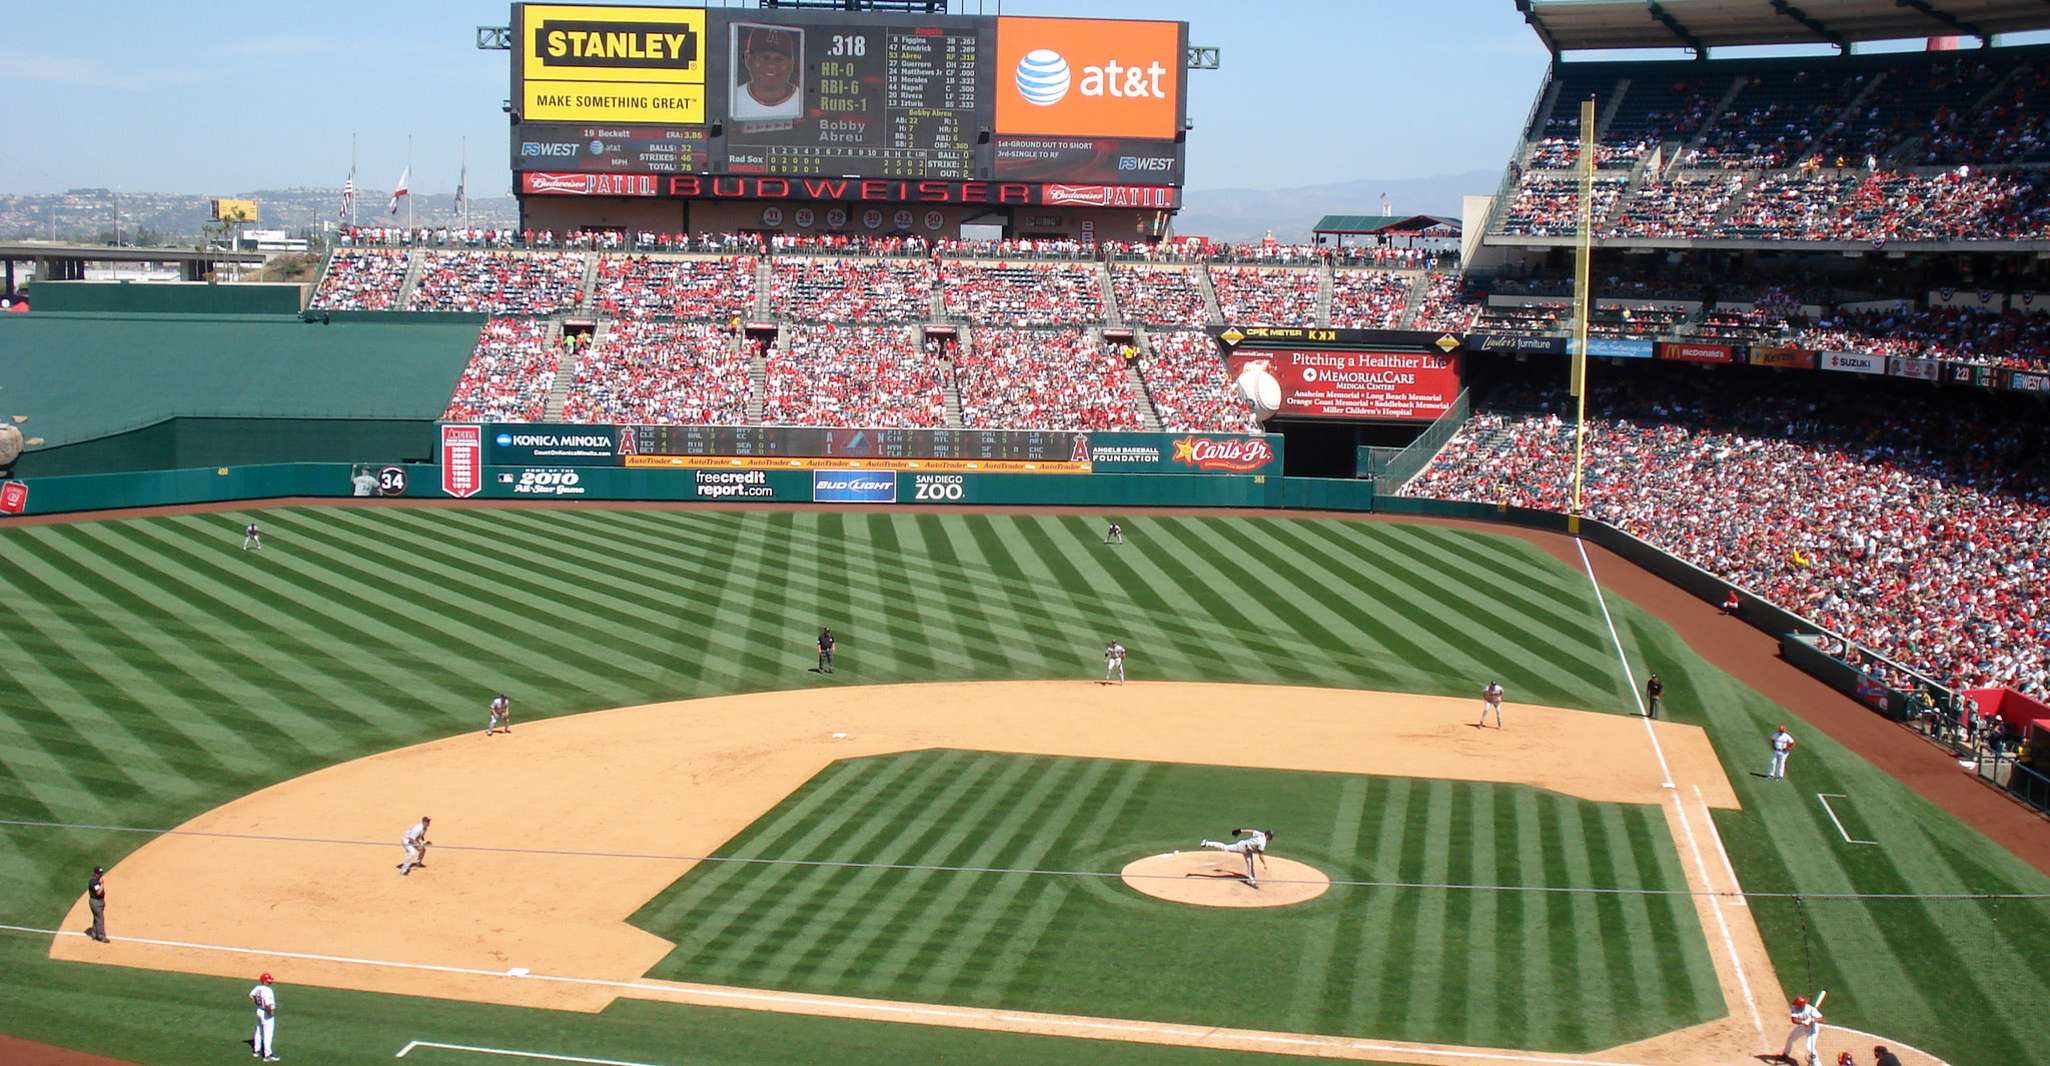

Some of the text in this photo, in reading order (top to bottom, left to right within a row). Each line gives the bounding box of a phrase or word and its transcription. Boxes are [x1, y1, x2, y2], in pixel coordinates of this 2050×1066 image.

[547, 30, 686, 59] STANLEY
[827, 35, 866, 56] .318
[1080, 60, 1166, 98] at&t
[537, 95, 690, 109] MAKE SOMETHING GREAT
[819, 120, 865, 133] Bobby
[598, 129, 630, 138] Beckett
[819, 131, 863, 142] Abreu
[729, 155, 764, 163] Red Sox
[938, 151, 960, 159] BALL:
[928, 160, 960, 168] STRIKE:
[532, 173, 650, 194] Budweiser PATIO
[669, 175, 1030, 203] BUDWEISER
[1051, 186, 1165, 207] Budweiser PATIO
[1269, 329, 1302, 337] METER
[1292, 353, 1447, 369] Pitching a Healthier Life
[1840, 357, 1871, 368] SUZUKI
[1294, 390, 1441, 401] Anaheim Memorial Long Beach Memorial
[1287, 397, 1449, 409] Orange Coast Memorial Saddleback Memorial
[1322, 406, 1412, 416] Miller Children's Hospital
[513, 435, 611, 447] KONICA MINOLTA
[1192, 439, 1271, 461] Carl's Jr.
[381, 473, 404, 489] 34
[519, 472, 579, 485] 2010
[696, 471, 766, 484] freecredit
[916, 475, 963, 484] SAN DIEGO
[556, 485, 585, 495] Game
[698, 483, 773, 498] report.com
[915, 484, 963, 499] ZOO
